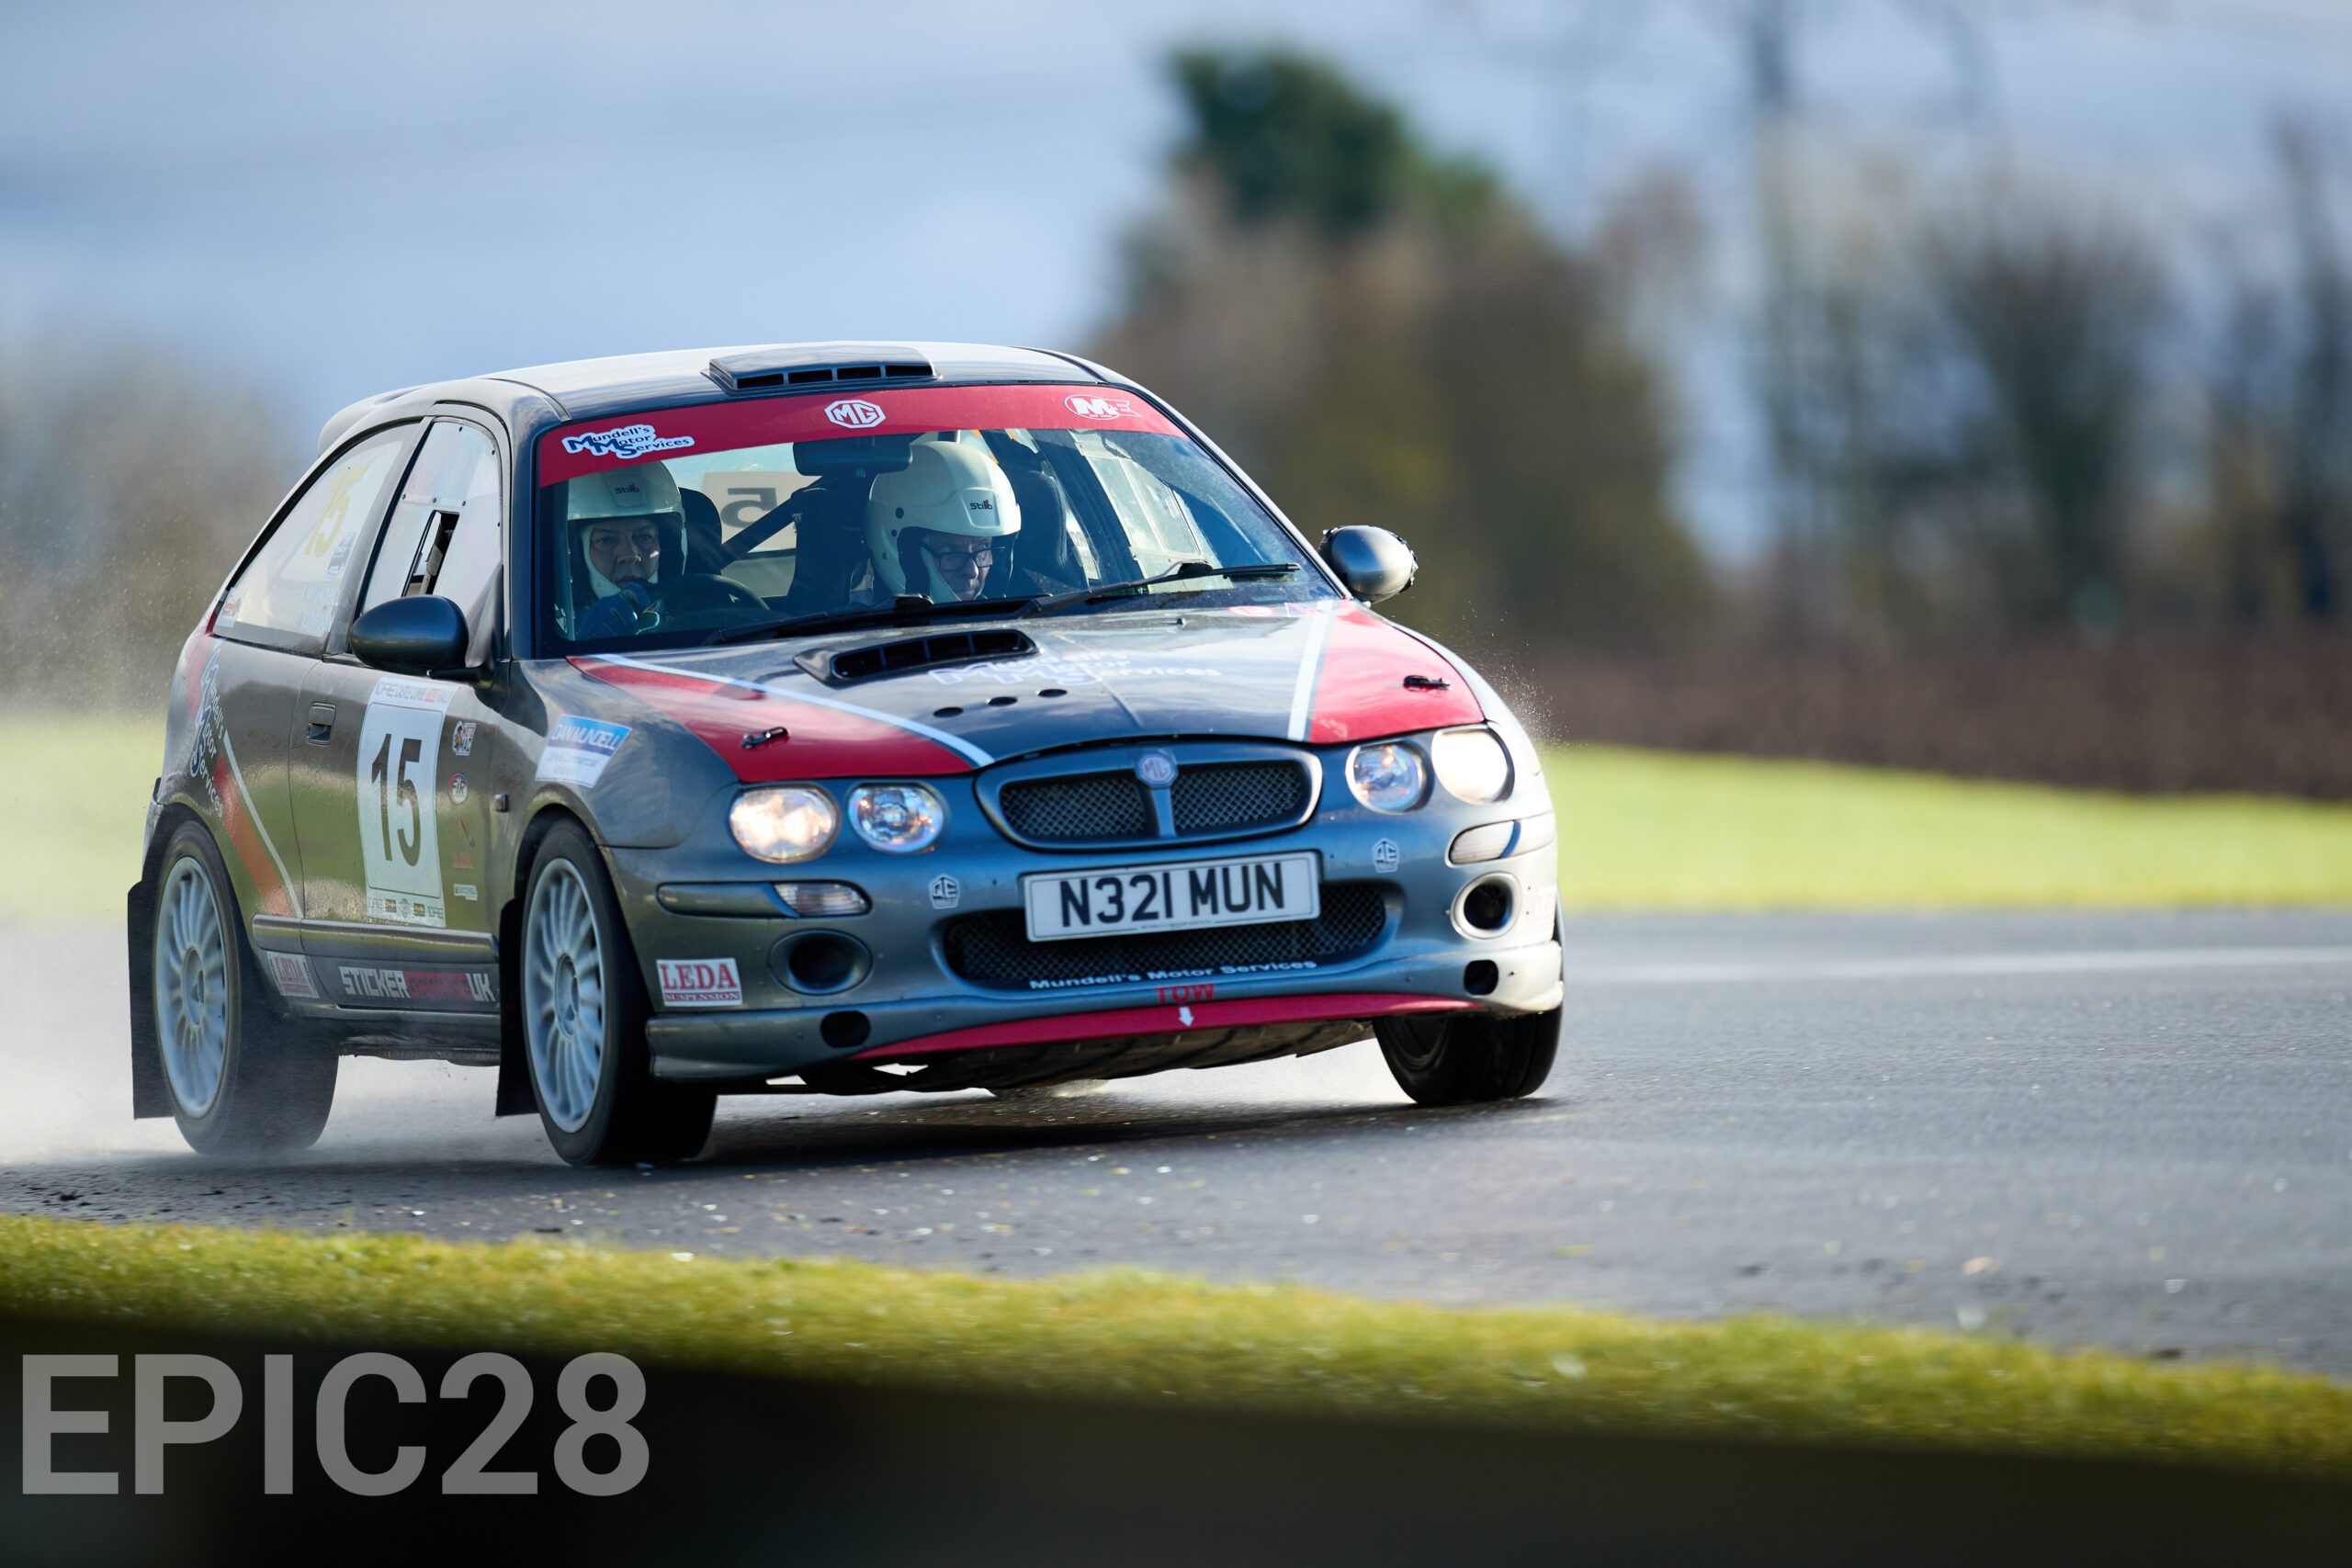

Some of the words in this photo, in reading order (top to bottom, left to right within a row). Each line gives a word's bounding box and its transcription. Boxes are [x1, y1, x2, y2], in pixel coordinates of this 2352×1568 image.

[831, 402, 879, 425] MG
[567, 426, 650, 451] Mundell's
[592, 434, 652, 454] Motor
[620, 439, 690, 457] Services
[303, 466, 368, 558] 15
[371, 732, 423, 867] 15
[1059, 872, 1173, 928] N321
[1189, 863, 1284, 917] MUN
[659, 963, 738, 990] LEDA
[1029, 974, 1142, 990] Mundell's
[1147, 967, 1214, 980] Motor
[1219, 960, 1317, 975] Services
[664, 991, 741, 1001] SUSPENSION
[1152, 983, 1216, 1004] TOW
